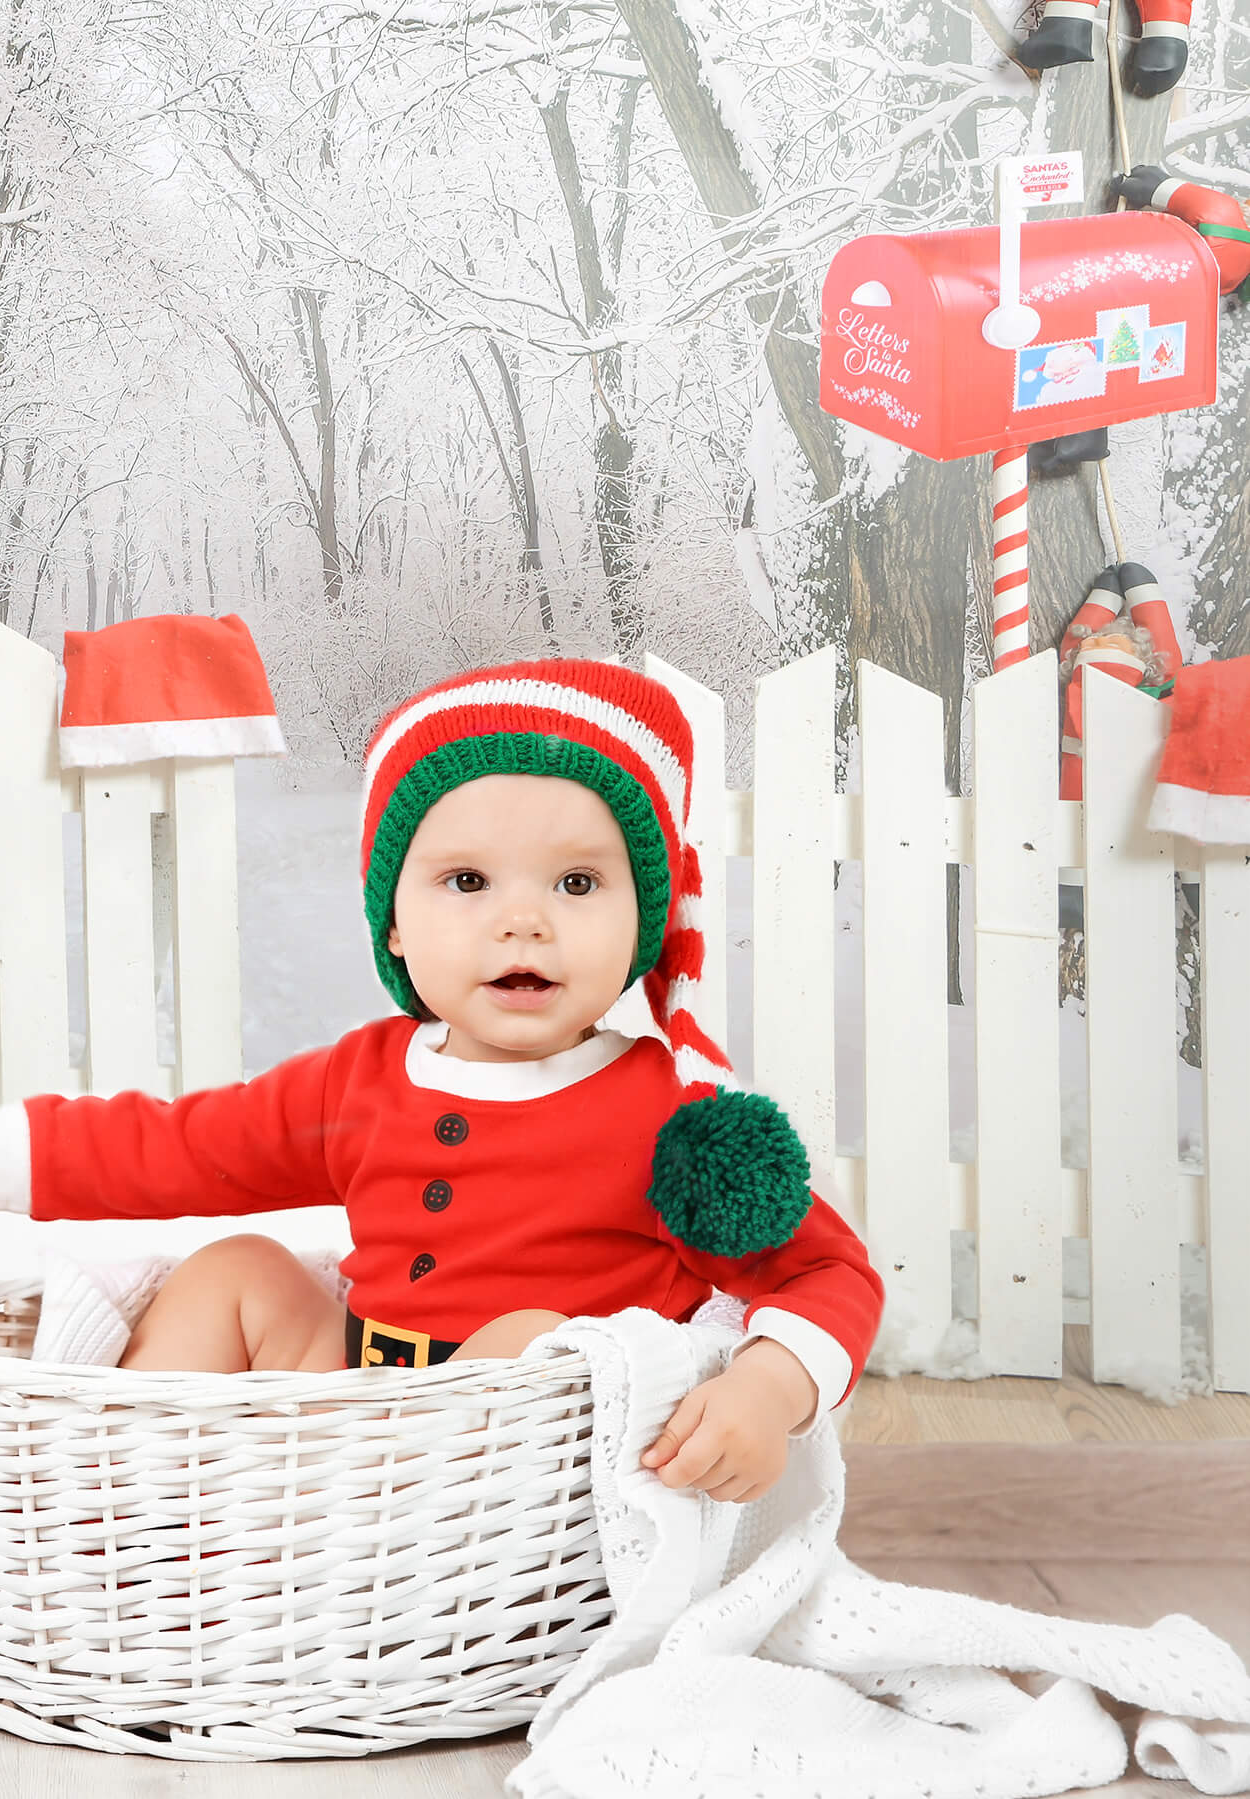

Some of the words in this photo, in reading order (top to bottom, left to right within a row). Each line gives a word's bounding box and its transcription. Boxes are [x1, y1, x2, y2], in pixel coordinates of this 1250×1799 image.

[1022, 162, 1069, 174] SANTA'S
[836, 308, 910, 353] Letters
[844, 346, 912, 384] Santa
[881, 349, 893, 362] to
